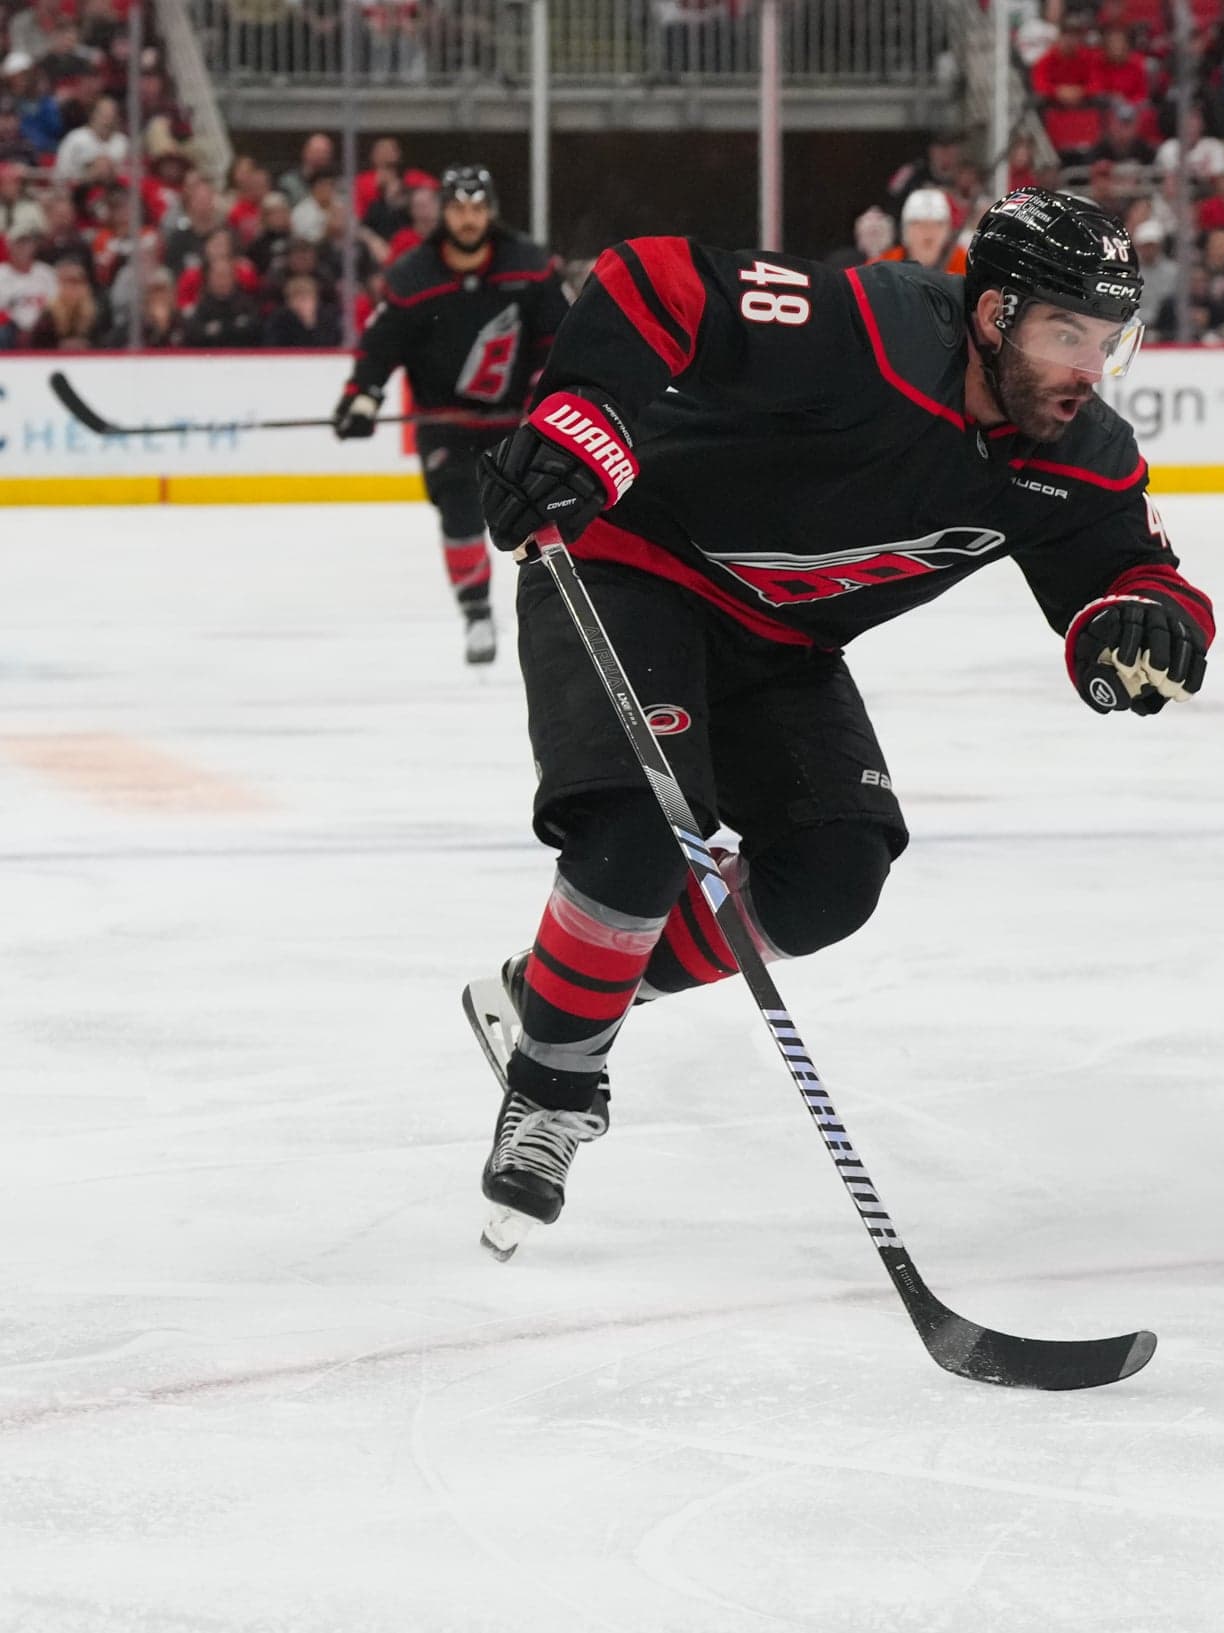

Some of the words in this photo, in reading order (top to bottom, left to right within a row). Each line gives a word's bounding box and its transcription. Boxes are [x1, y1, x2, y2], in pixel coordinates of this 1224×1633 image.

[739, 260, 811, 326] 48
[1095, 282, 1136, 298] CCM
[1142, 491, 1167, 548] 4
[762, 1009, 905, 1248] WARRIOR
